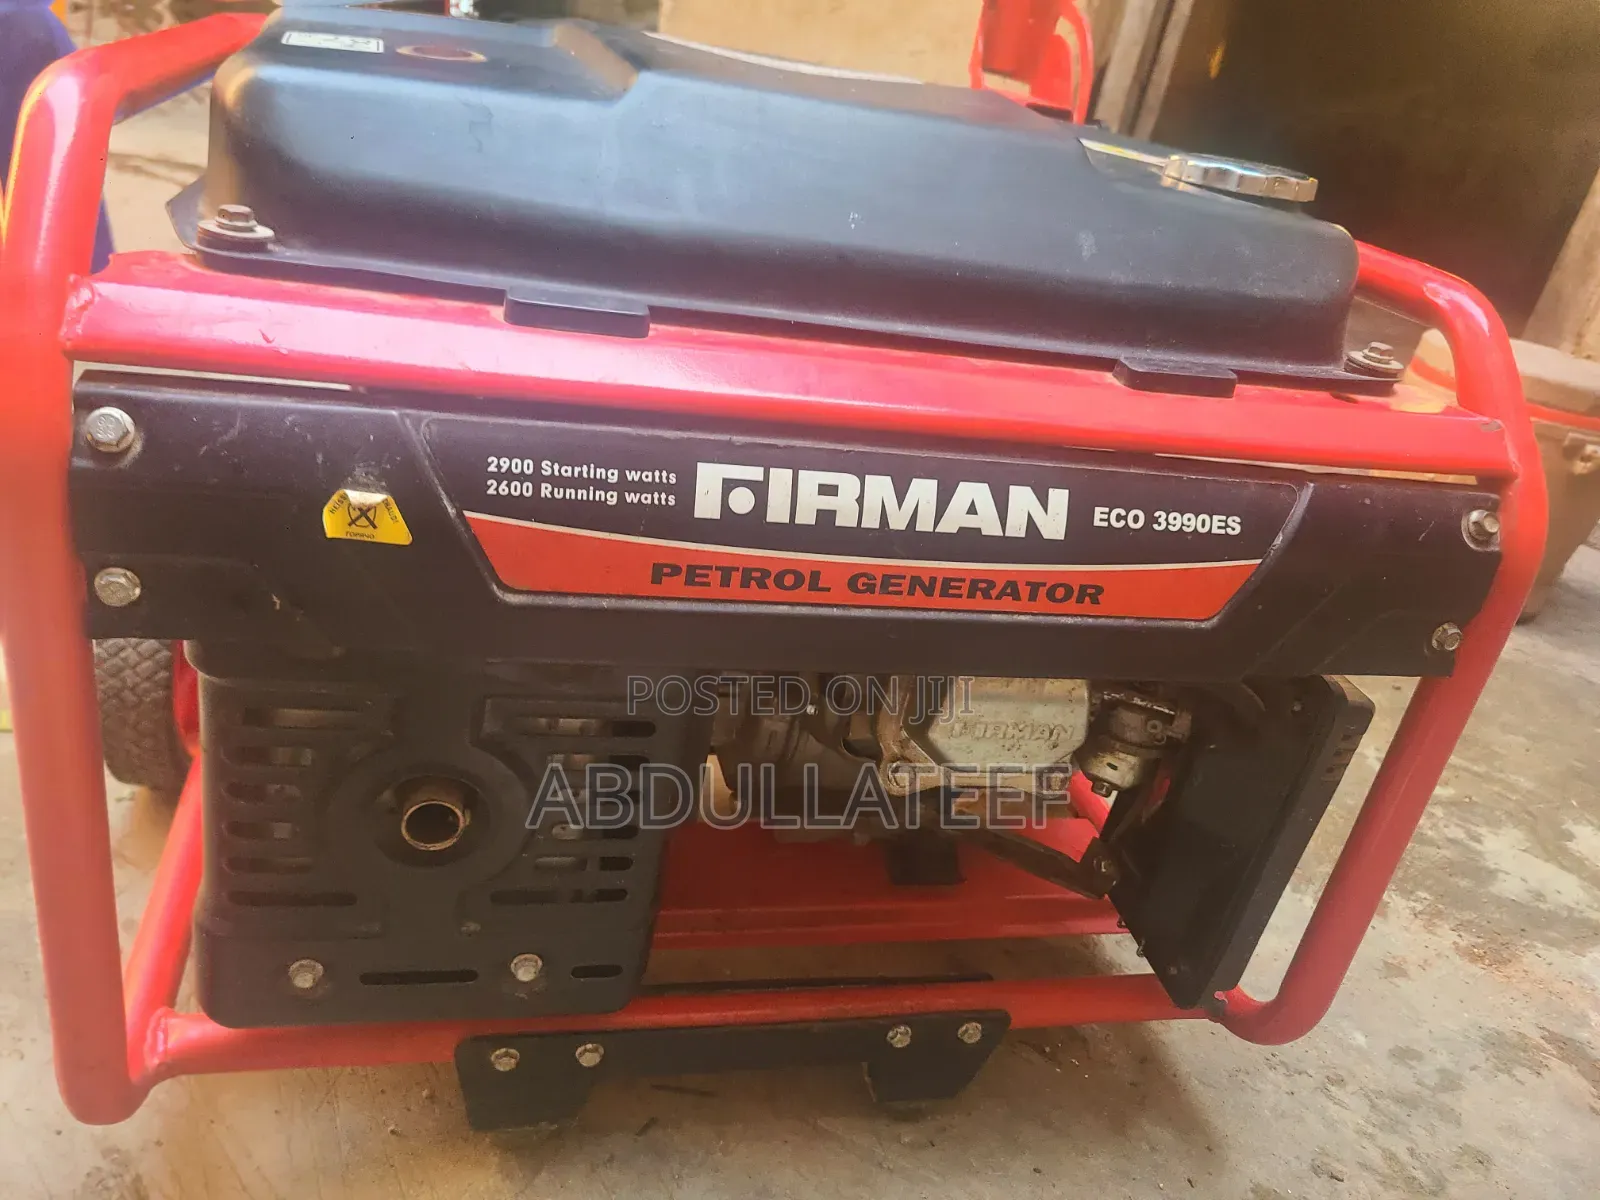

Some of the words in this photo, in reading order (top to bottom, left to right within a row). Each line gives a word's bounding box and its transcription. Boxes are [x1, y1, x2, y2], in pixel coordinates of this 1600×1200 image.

[486, 456, 534, 475] 2900
[540, 460, 619, 484] Starting
[625, 469, 677, 485] watts
[486, 479, 533, 498] 2600
[540, 485, 617, 505] Running
[624, 491, 676, 507] watts
[694, 462, 1070, 541] FIRMAN
[1093, 506, 1145, 529] ECO
[1152, 510, 1242, 536] 3990ES
[650, 562, 832, 593] PETROL
[846, 570, 1105, 605] GENERATOR
